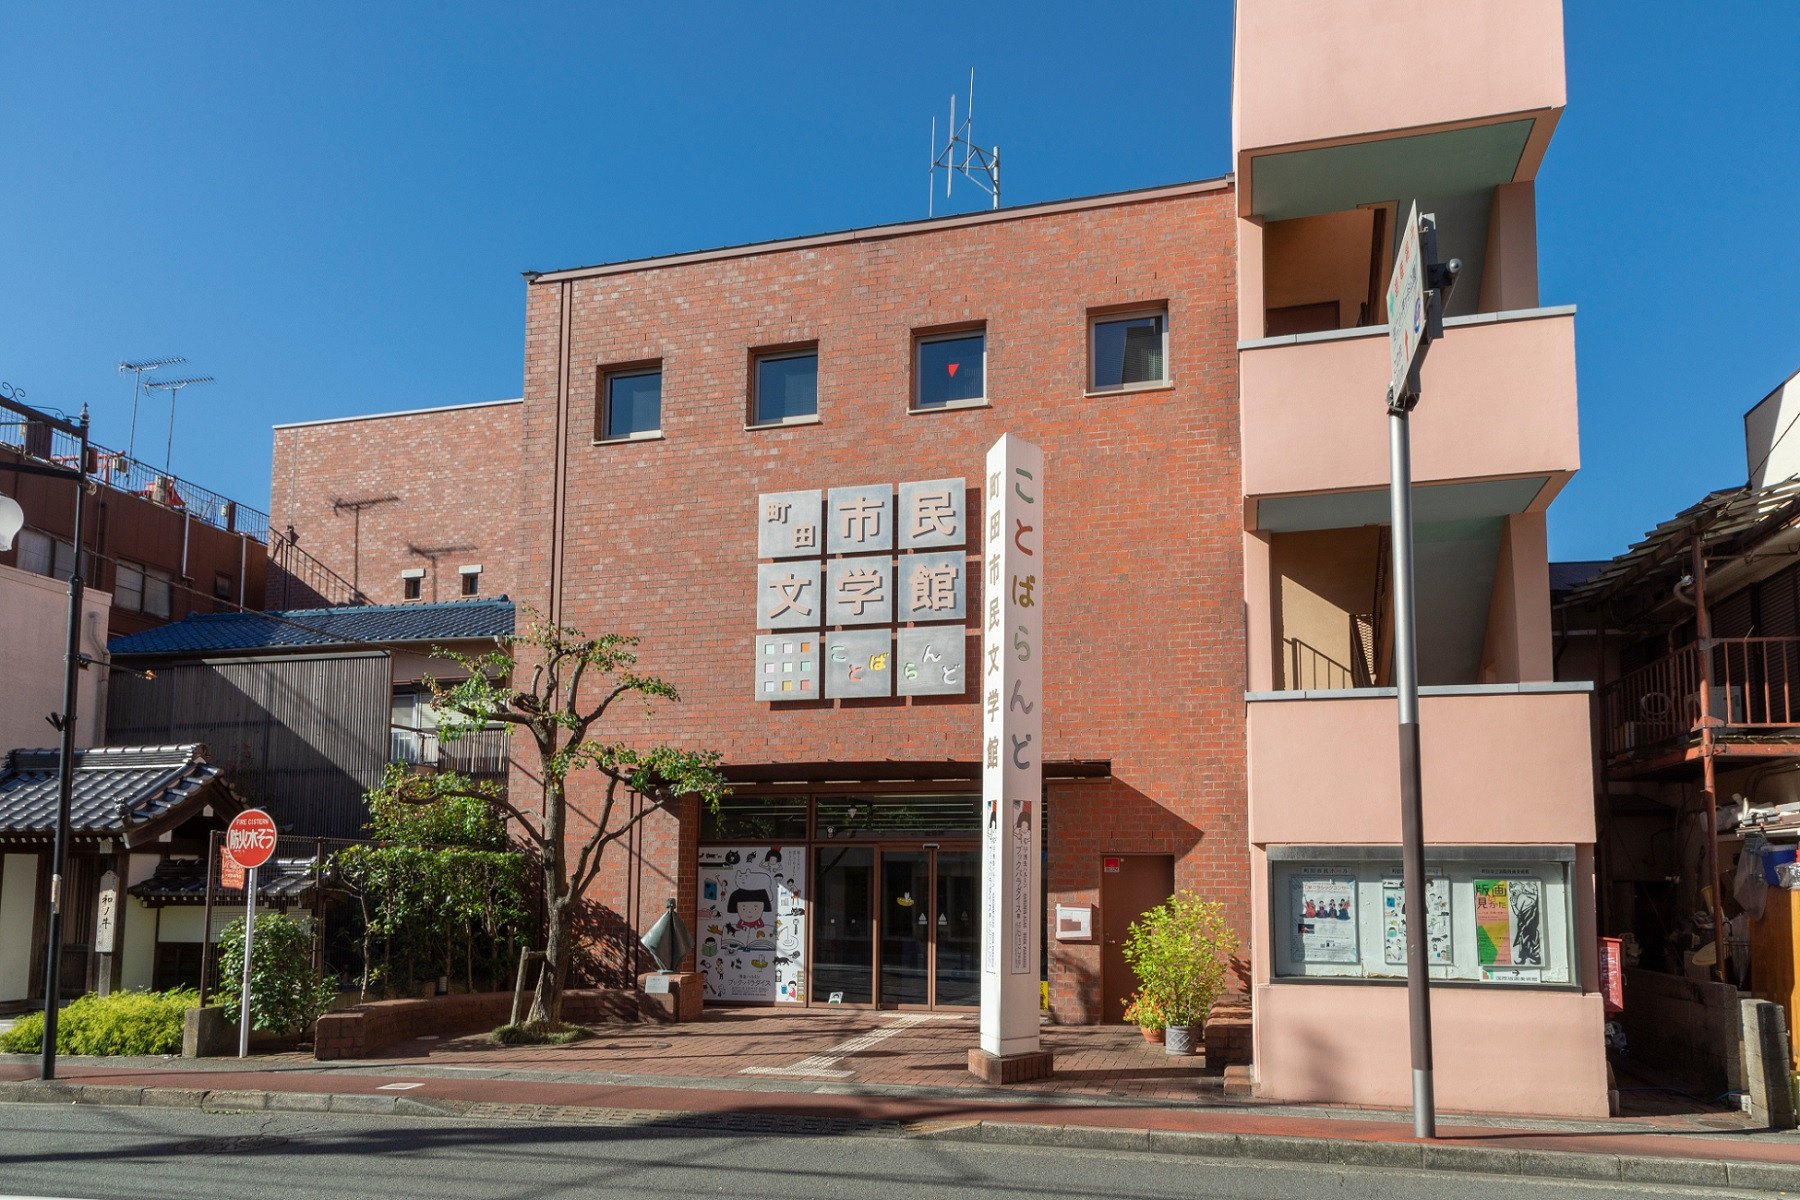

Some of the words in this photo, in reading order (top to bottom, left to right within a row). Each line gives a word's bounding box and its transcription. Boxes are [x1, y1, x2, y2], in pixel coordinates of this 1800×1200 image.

[767, 562, 960, 620] 文学館
[986, 470, 1002, 770] 町田市民文学館
[1009, 467, 1035, 771] ことばらんど
[830, 644, 961, 685] ことばらんど
[247, 818, 269, 826] CISTERN
[1476, 884, 1507, 898] 版画
[1477, 896, 1507, 909] 見かた
